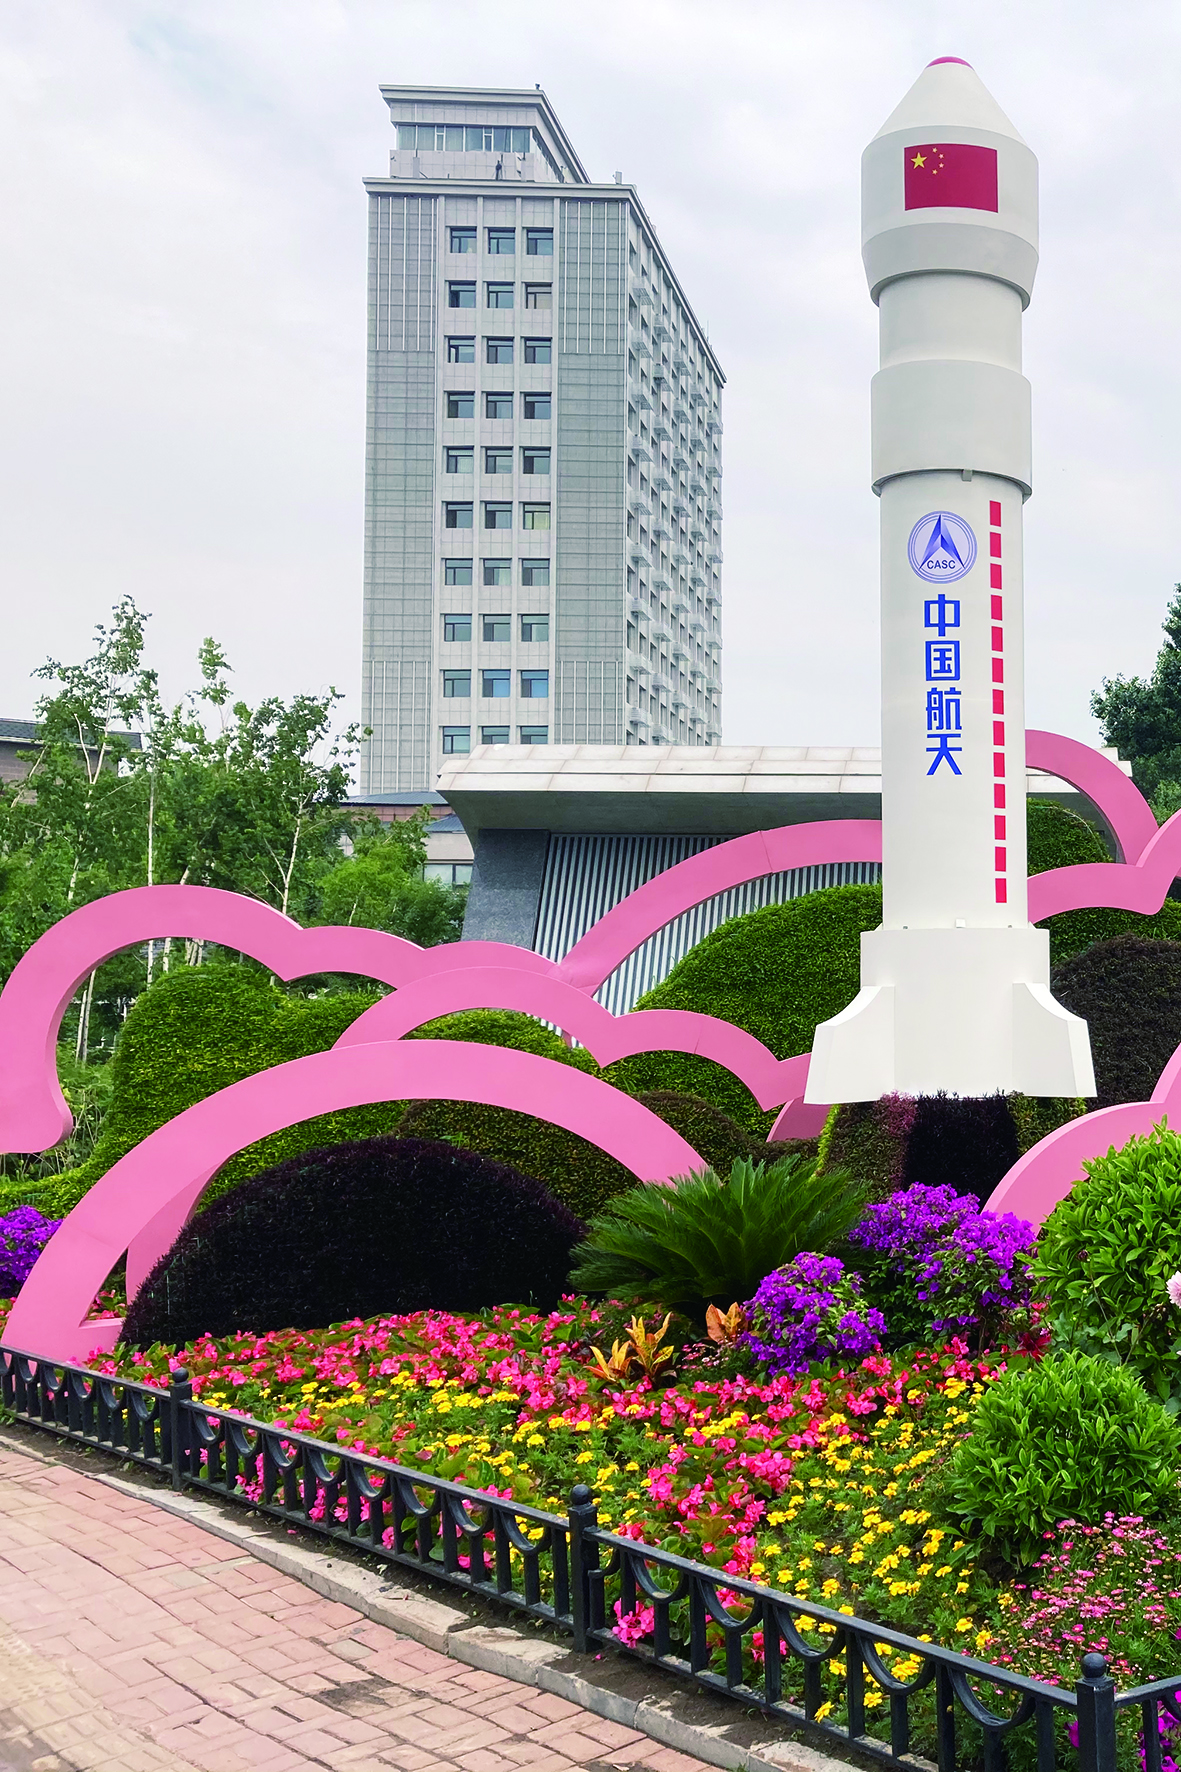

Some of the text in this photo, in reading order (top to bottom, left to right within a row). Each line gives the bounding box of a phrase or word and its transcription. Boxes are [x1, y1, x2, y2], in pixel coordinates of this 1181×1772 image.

[926, 559, 956, 570] CASC
[923, 593, 963, 776] 中国航天
